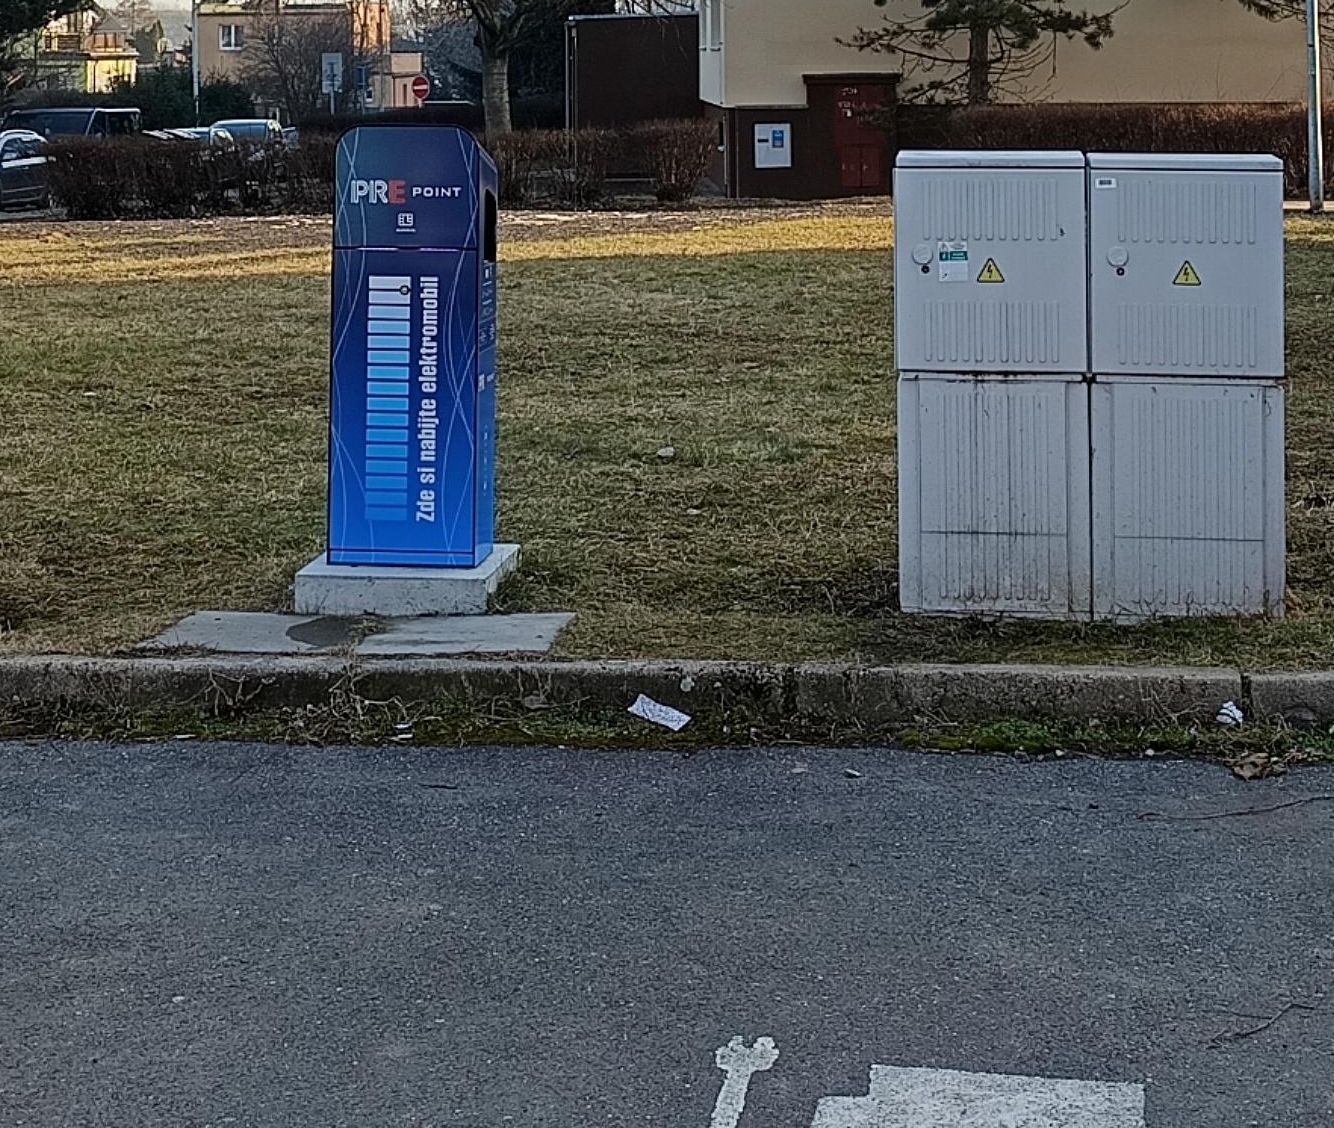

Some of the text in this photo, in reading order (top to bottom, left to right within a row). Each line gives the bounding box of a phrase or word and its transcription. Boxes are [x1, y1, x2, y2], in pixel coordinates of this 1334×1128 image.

[350, 179, 463, 204] PRE POINT
[415, 276, 440, 523] Zde si nabijte elektromobil
